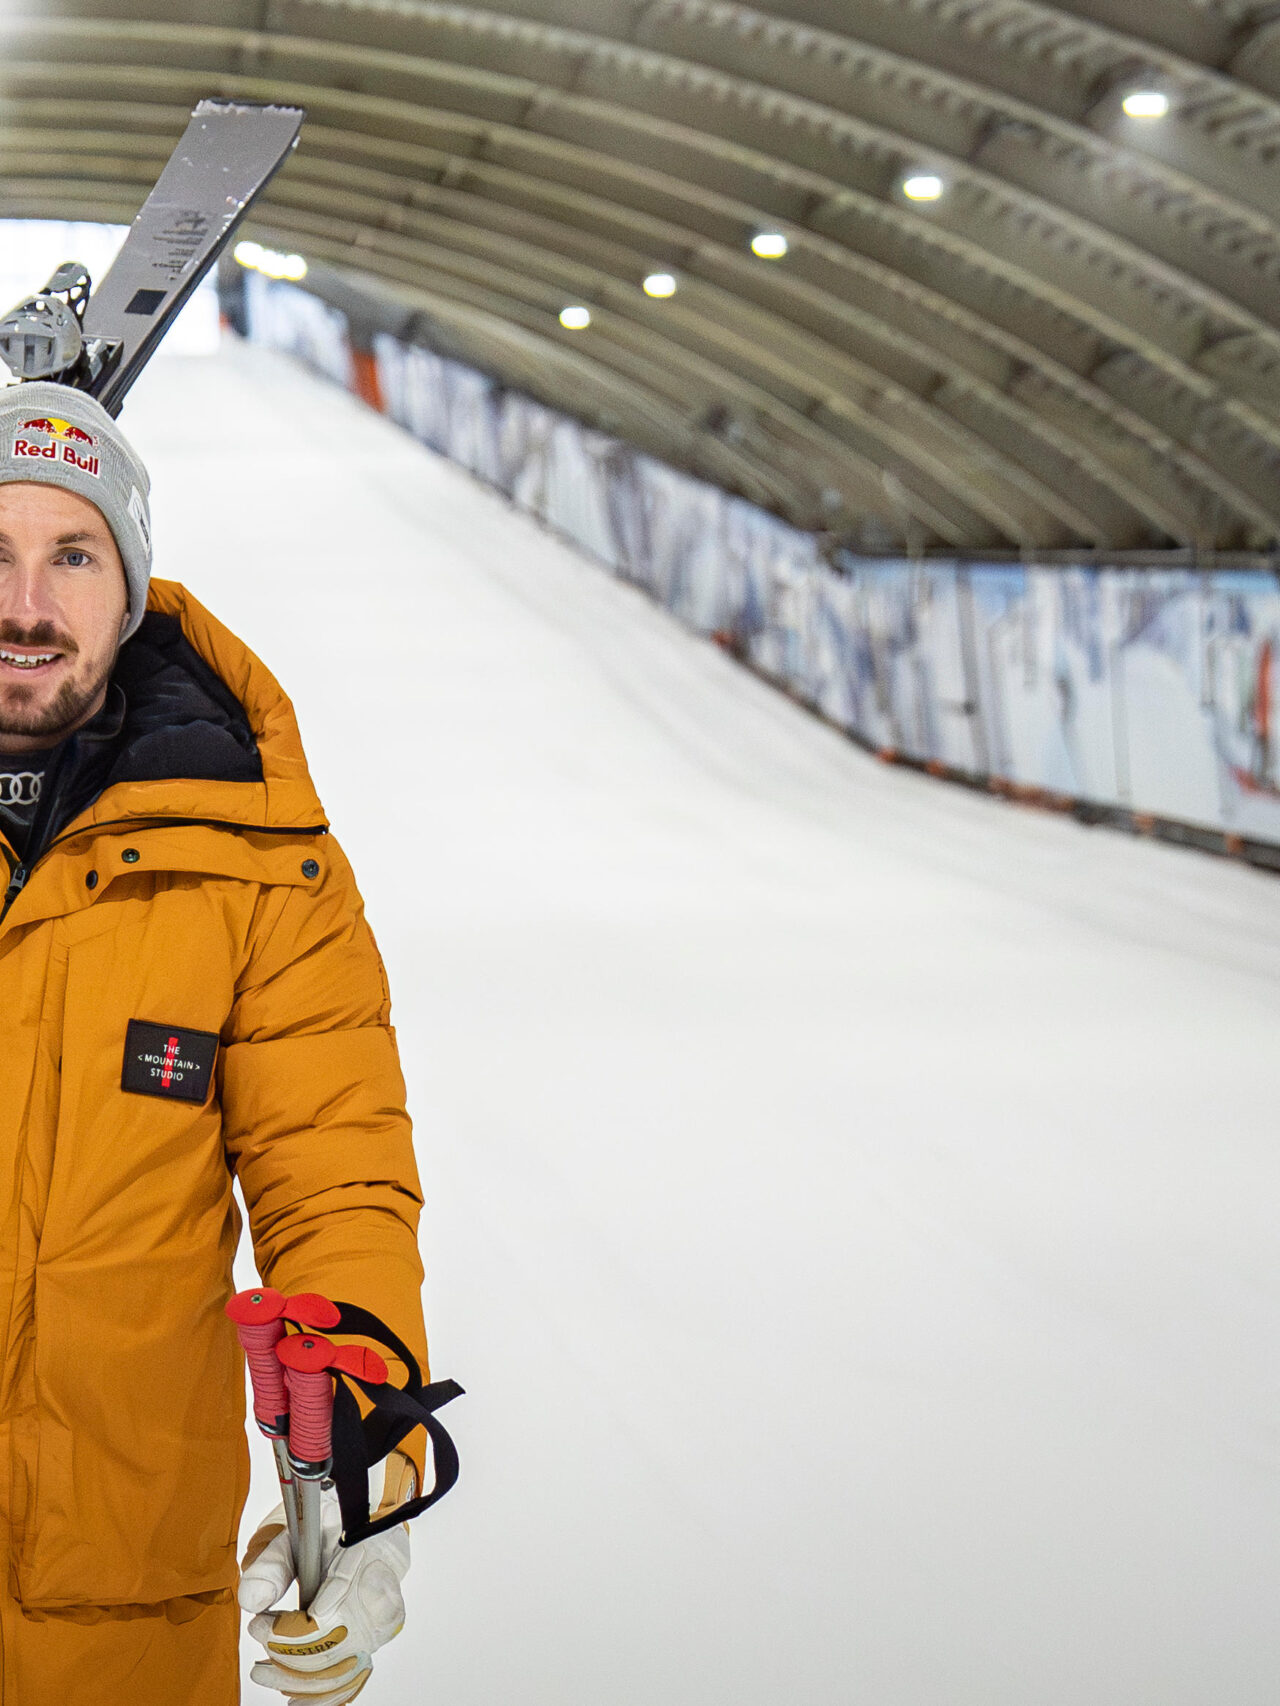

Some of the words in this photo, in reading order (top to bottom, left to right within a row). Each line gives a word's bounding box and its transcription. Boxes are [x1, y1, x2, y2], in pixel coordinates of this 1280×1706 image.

[14, 439, 57, 459] Red
[63, 446, 99, 476] Bull
[163, 1044, 181, 1055] THE
[150, 1067, 184, 1081] STUDIO
